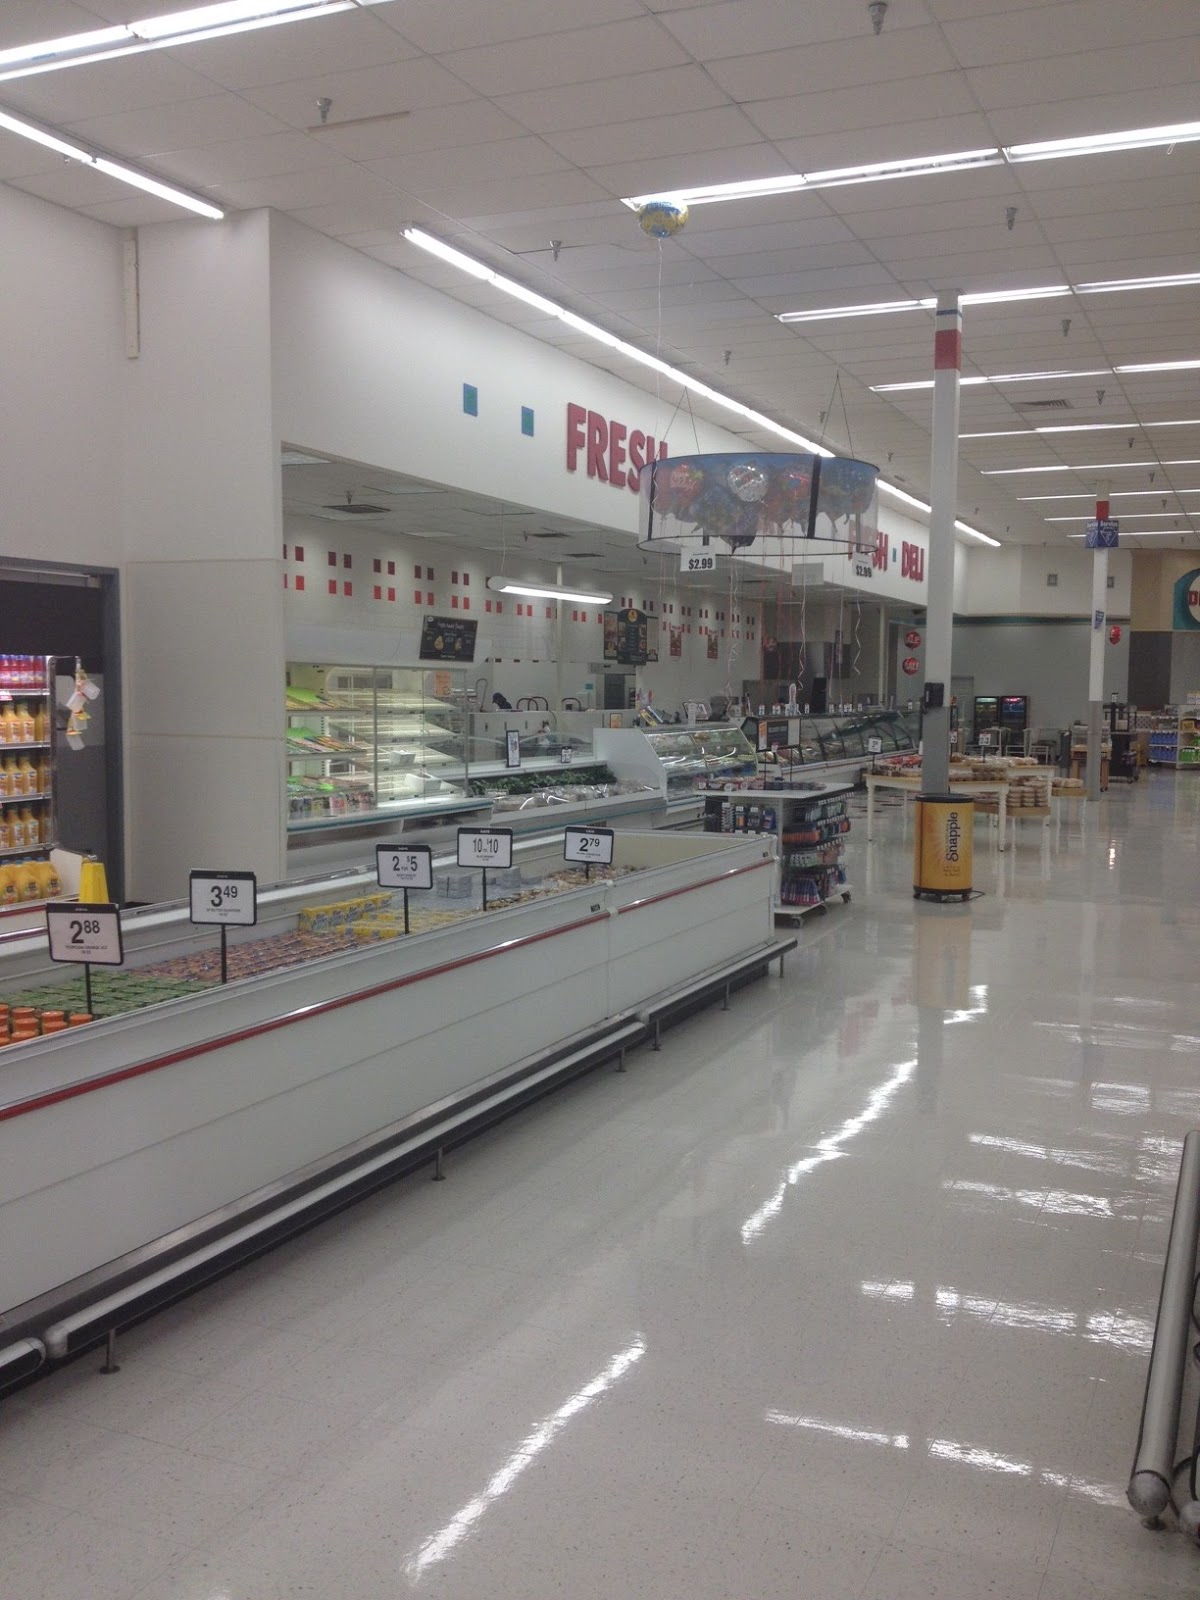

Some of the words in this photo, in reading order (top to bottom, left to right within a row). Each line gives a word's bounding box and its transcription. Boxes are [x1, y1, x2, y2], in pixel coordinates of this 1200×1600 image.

[688, 557, 713, 570] $2.99
[901, 540, 924, 582] DELI
[856, 564, 872, 578] $2.99
[945, 811, 961, 862] Snapple
[473, 838, 483, 853] 10
[392, 855, 401, 871] 2
[406, 855, 418, 871] $5
